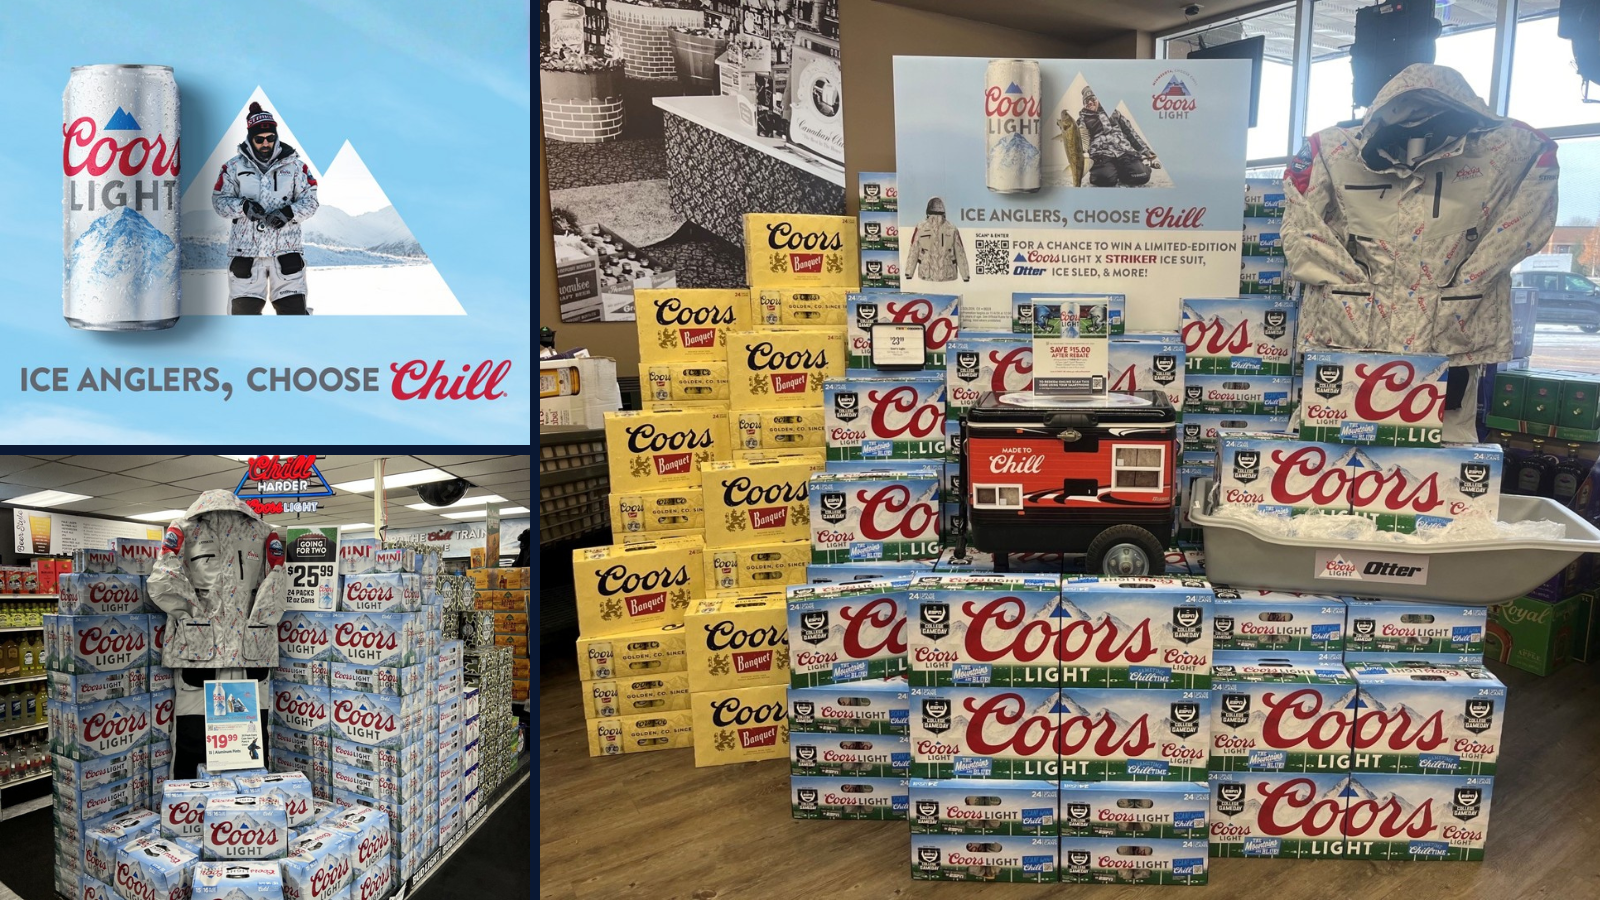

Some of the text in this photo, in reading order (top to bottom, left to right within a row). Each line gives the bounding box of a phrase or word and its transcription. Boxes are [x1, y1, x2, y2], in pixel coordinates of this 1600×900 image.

[985, 86, 1042, 118] Coors
[1152, 94, 1196, 110] Coors
[1159, 111, 1189, 119] LIGHT
[798, 120, 831, 140] Canadian
[989, 119, 1040, 134] LIGHT
[62, 117, 181, 177] Coors
[70, 180, 177, 211] LIGHT
[961, 206, 1206, 228] ICE ANGLERS, CHOOSE Chill
[766, 222, 842, 250] Coors
[1012, 241, 1236, 252] FOR A CHANCE TO WIN A LIMITED-EDITION
[794, 255, 821, 270] Banquet
[1028, 250, 1206, 266] Coors LIGHT X STRIKER ICE SUIT,
[1013, 266, 1148, 278] Otter ICE SLED, & MORE!
[559, 278, 590, 295] waukee
[654, 298, 736, 326] Coors
[684, 328, 712, 346] Banquet
[746, 342, 828, 370] Coors
[20, 359, 512, 401] ICE ANGLERS, CHOOSE Chill
[775, 374, 804, 392] Banquet
[626, 424, 714, 453] Coors
[831, 428, 866, 440] Coors
[248, 455, 316, 481] Chill
[657, 455, 690, 474] Banquet
[990, 454, 1045, 474] Chill
[258, 481, 308, 492] HARDER
[1271, 446, 1444, 512] Coors
[721, 476, 809, 506] Coors
[246, 499, 318, 514] Coors LIGHT
[753, 509, 786, 528] Banquet
[408, 533, 426, 542] THE
[427, 530, 453, 541] Chill
[1326, 560, 1356, 572] Coors
[1363, 562, 1424, 578] Otter
[595, 565, 690, 596] Coors
[89, 583, 140, 604] Coors
[347, 581, 394, 601] Coors
[102, 604, 129, 612] LIGHT
[356, 601, 382, 610] LIGHT
[630, 594, 664, 614] Banquet
[1500, 600, 1550, 624] Royal
[278, 620, 328, 645] Coors
[335, 622, 398, 650] Coors
[704, 620, 788, 650] Coors
[962, 597, 1158, 662] Coors
[1382, 624, 1448, 637] Coors LIGHT
[287, 644, 316, 654] LIGHT
[348, 648, 382, 665] LIGHT
[915, 646, 958, 662] Coors
[737, 652, 770, 672] Banquet
[1025, 667, 1090, 683] LIGHT
[334, 700, 396, 732] Coors
[821, 707, 854, 719] Coors
[1262, 689, 1448, 750] Coors
[82, 712, 148, 742] Coors
[347, 725, 380, 740] LIGHT
[964, 693, 1155, 756] Coors
[100, 734, 134, 750] LIGHT
[743, 728, 775, 748] Banquet
[1454, 739, 1494, 754] Coors
[918, 741, 960, 755] Coors
[1025, 761, 1090, 775] LIGHT
[1318, 754, 1382, 769] LIGHT
[946, 806, 1018, 820] Coors LIGHT
[1098, 809, 1169, 822] Coors LIGHT
[1258, 778, 1438, 838] Coors
[211, 822, 278, 846] Coors
[226, 846, 262, 856] LIGHT
[1312, 841, 1372, 855] LIGHT
